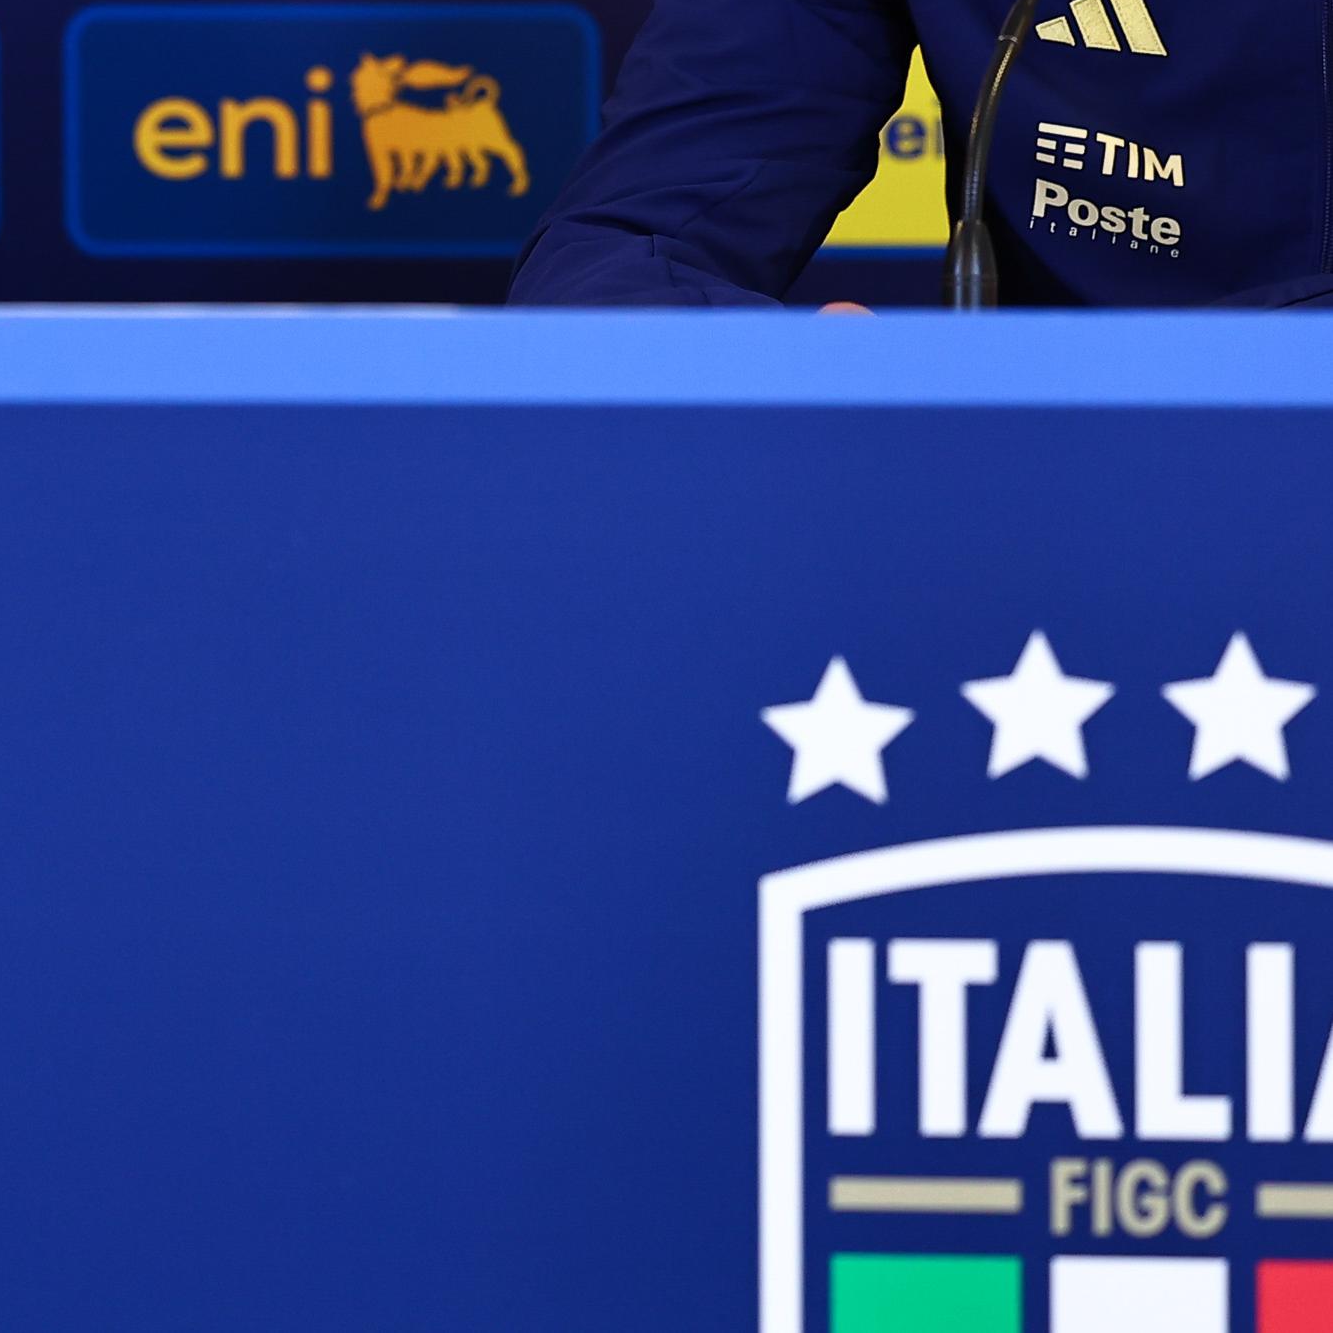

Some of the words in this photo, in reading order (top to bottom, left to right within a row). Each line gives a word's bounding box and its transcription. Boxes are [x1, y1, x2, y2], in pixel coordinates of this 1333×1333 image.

[133, 66, 335, 180] eni
[1095, 132, 1184, 187] TIM
[1032, 178, 1182, 246] Poste
[827, 936, 1333, 1143] ITALI
[1048, 1156, 1229, 1238] FIGC
